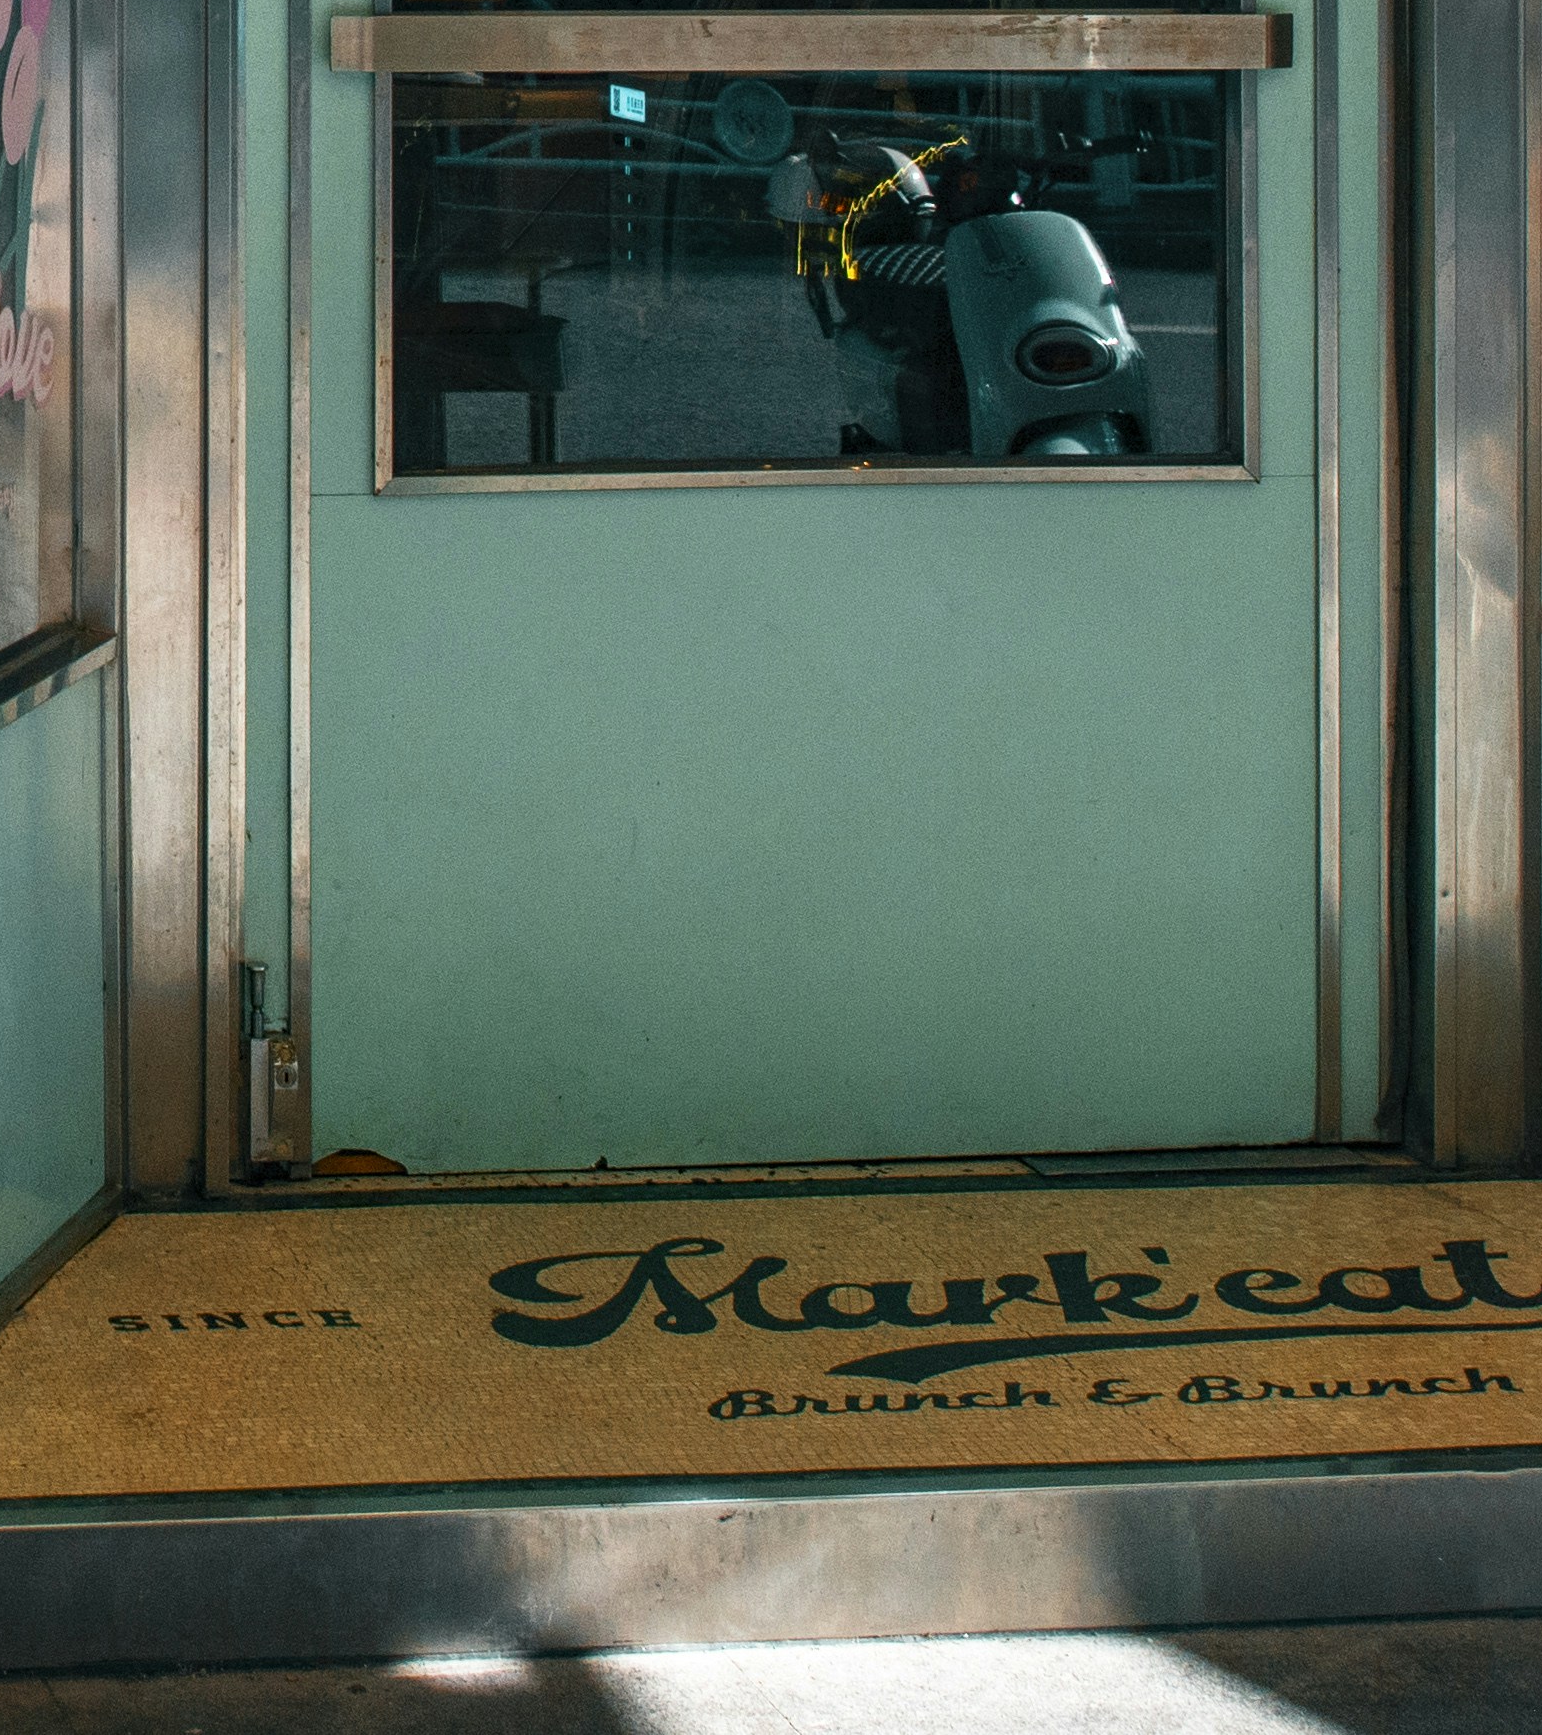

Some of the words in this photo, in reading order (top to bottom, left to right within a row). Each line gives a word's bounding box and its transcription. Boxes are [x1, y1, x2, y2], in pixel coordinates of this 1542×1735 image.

[106, 1308, 366, 1333] SINCE
[706, 1378, 1054, 1424] Brunch
[1088, 1373, 1165, 1409] &
[1176, 1365, 1524, 1408] Brunch
